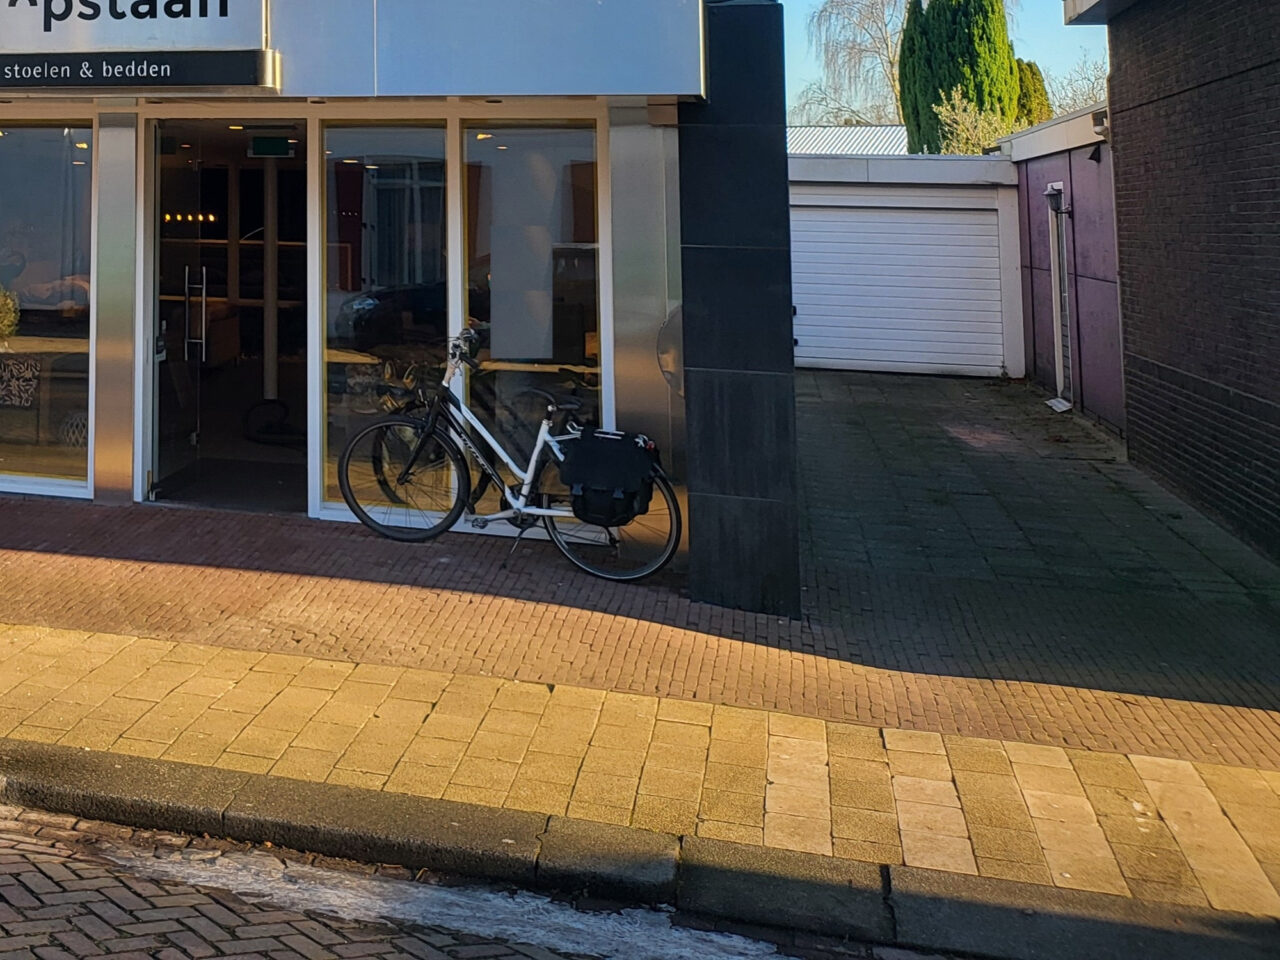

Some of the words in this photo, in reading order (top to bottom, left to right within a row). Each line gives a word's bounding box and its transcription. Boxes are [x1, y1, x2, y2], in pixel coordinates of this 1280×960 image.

[4, 61, 71, 79] stoelen
[79, 60, 94, 79] &
[102, 59, 171, 78] bedden
